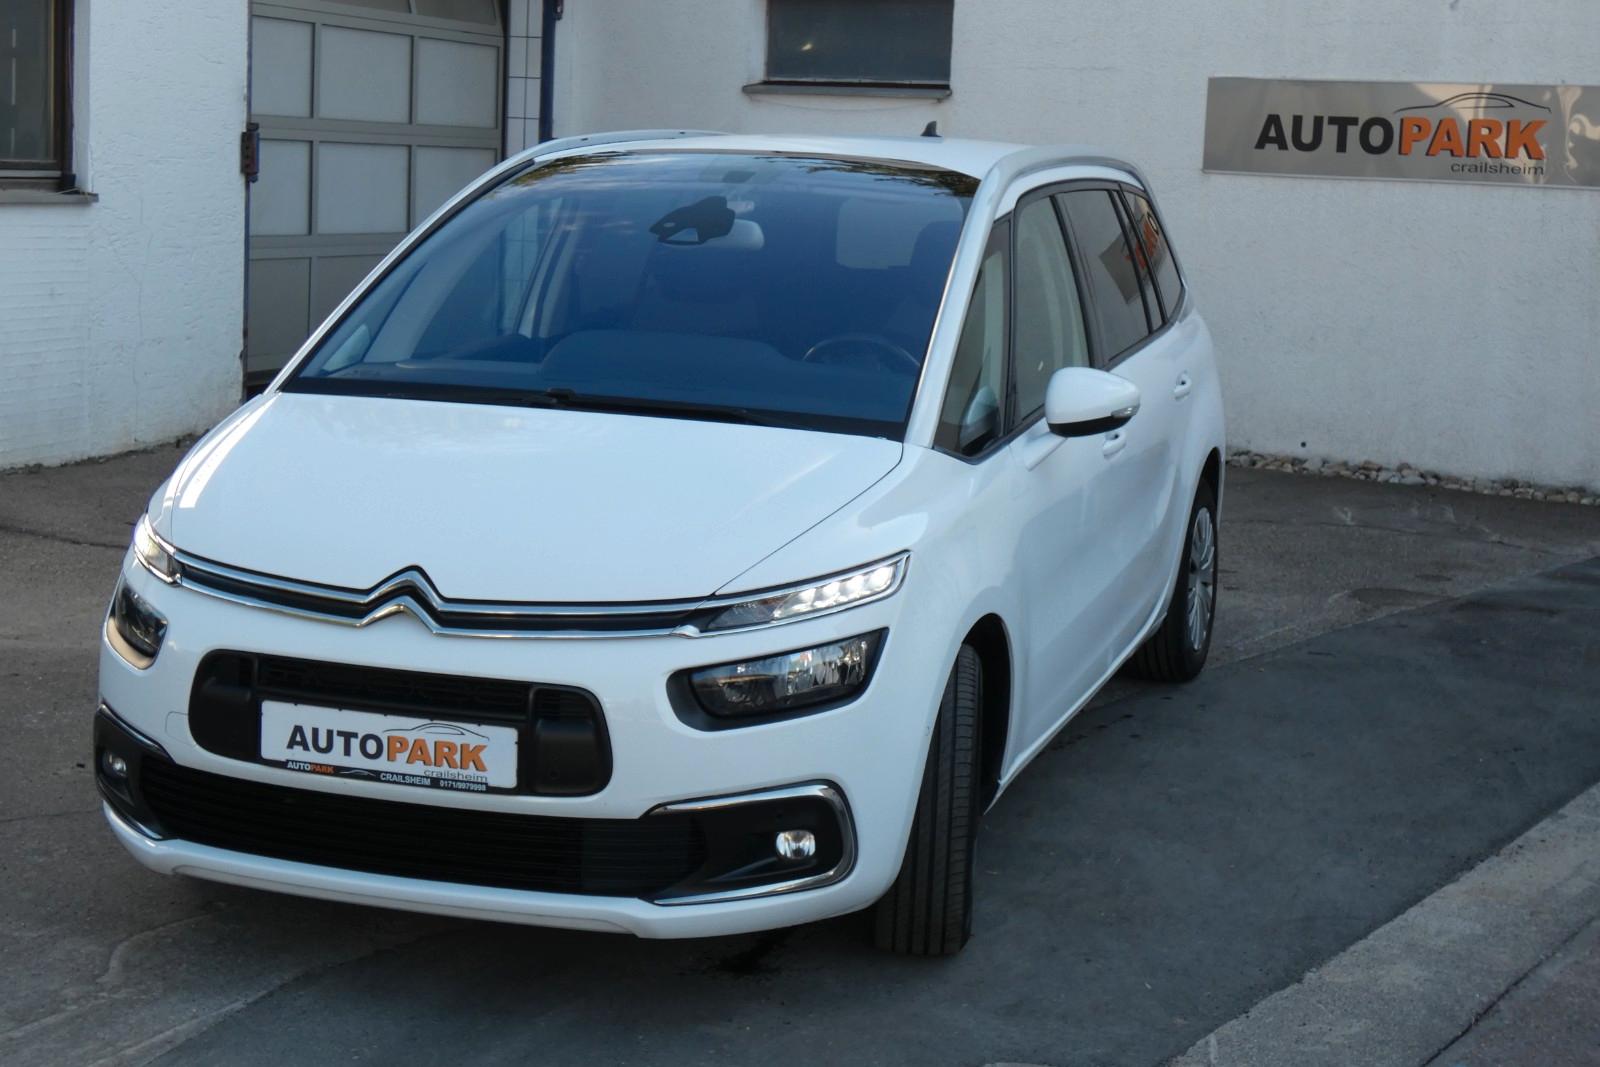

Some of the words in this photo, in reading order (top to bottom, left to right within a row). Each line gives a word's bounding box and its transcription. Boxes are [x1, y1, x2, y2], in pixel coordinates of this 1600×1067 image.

[1254, 114, 1546, 160] AUTOPARK
[1450, 161, 1545, 176] crailsheim
[286, 724, 488, 772] AUTOPARK
[286, 761, 335, 774] AUTOPARK
[379, 772, 431, 786] CRAILSHEIM
[423, 768, 488, 783] crailsheim
